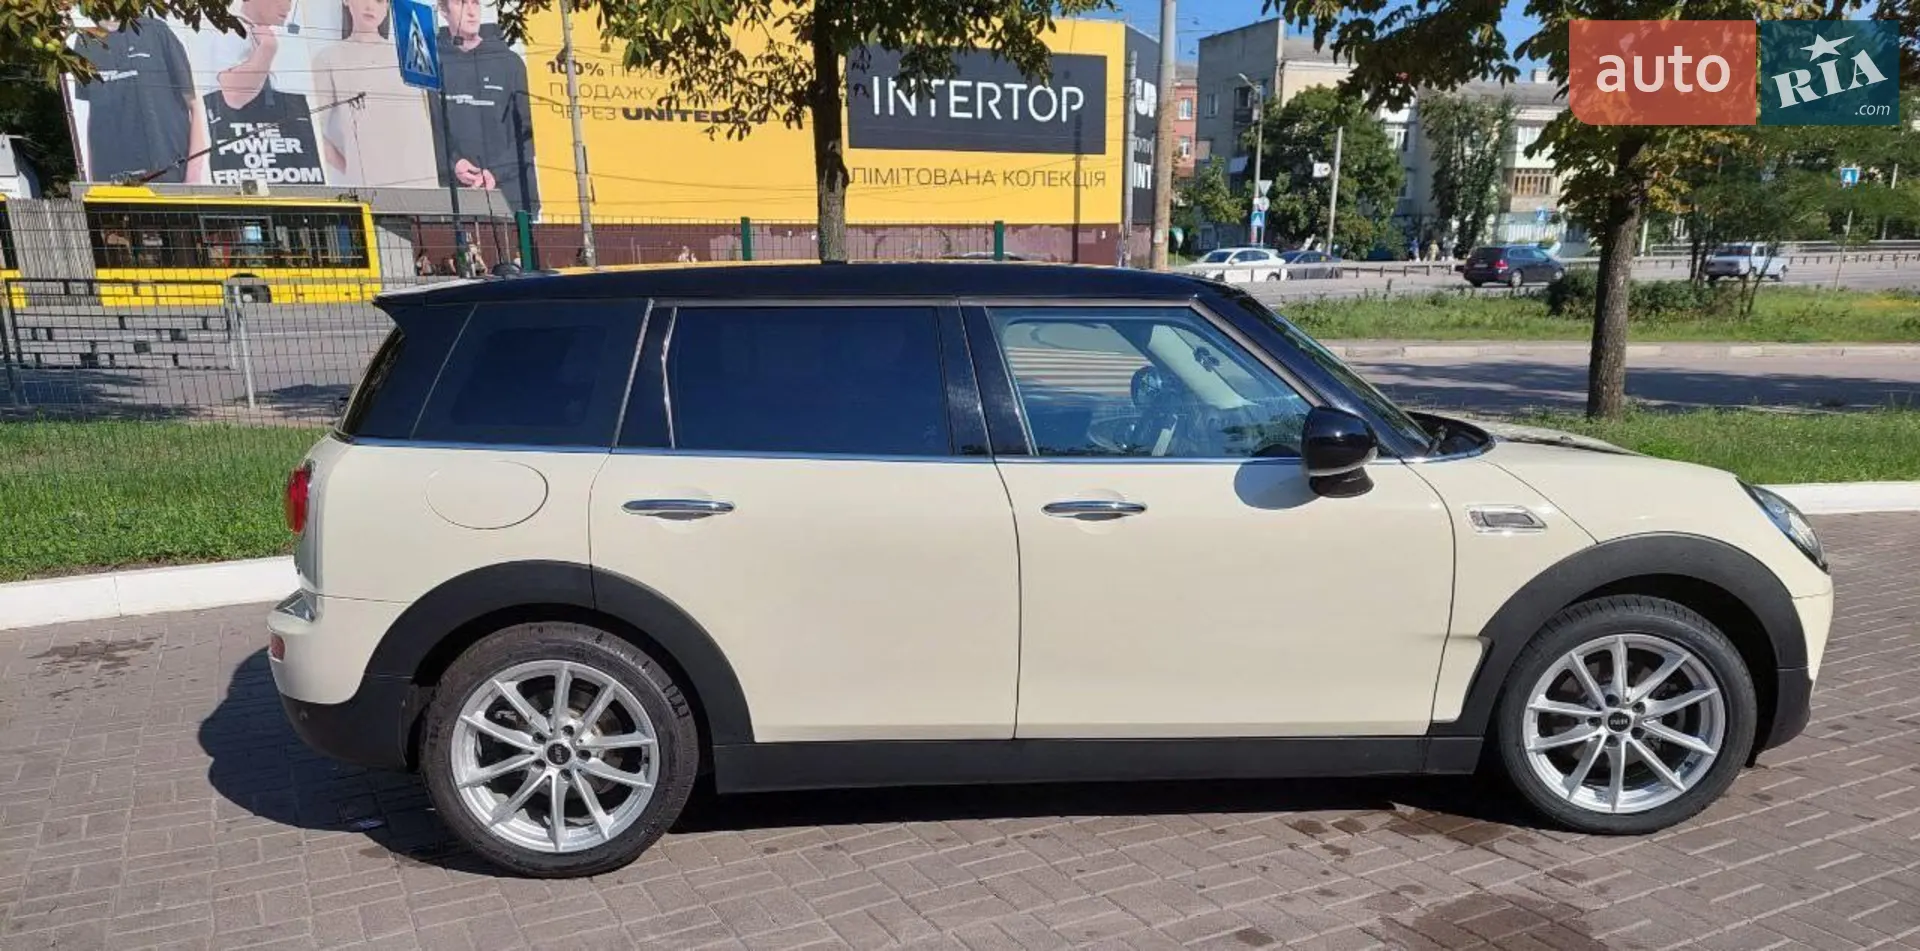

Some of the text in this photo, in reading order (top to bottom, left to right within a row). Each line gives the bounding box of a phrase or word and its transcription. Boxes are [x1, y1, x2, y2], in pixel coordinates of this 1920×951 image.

[547, 60, 605, 77] 100%
[549, 81, 659, 101] ПОДАЖУ
[872, 75, 1085, 123] INTERTOP
[217, 137, 304, 155] POWER
[243, 152, 277, 169] OF
[212, 166, 324, 185] FREEDOM
[849, 167, 1106, 190] ЛІМІТОВАНА КОЛЕКЦІЯ
